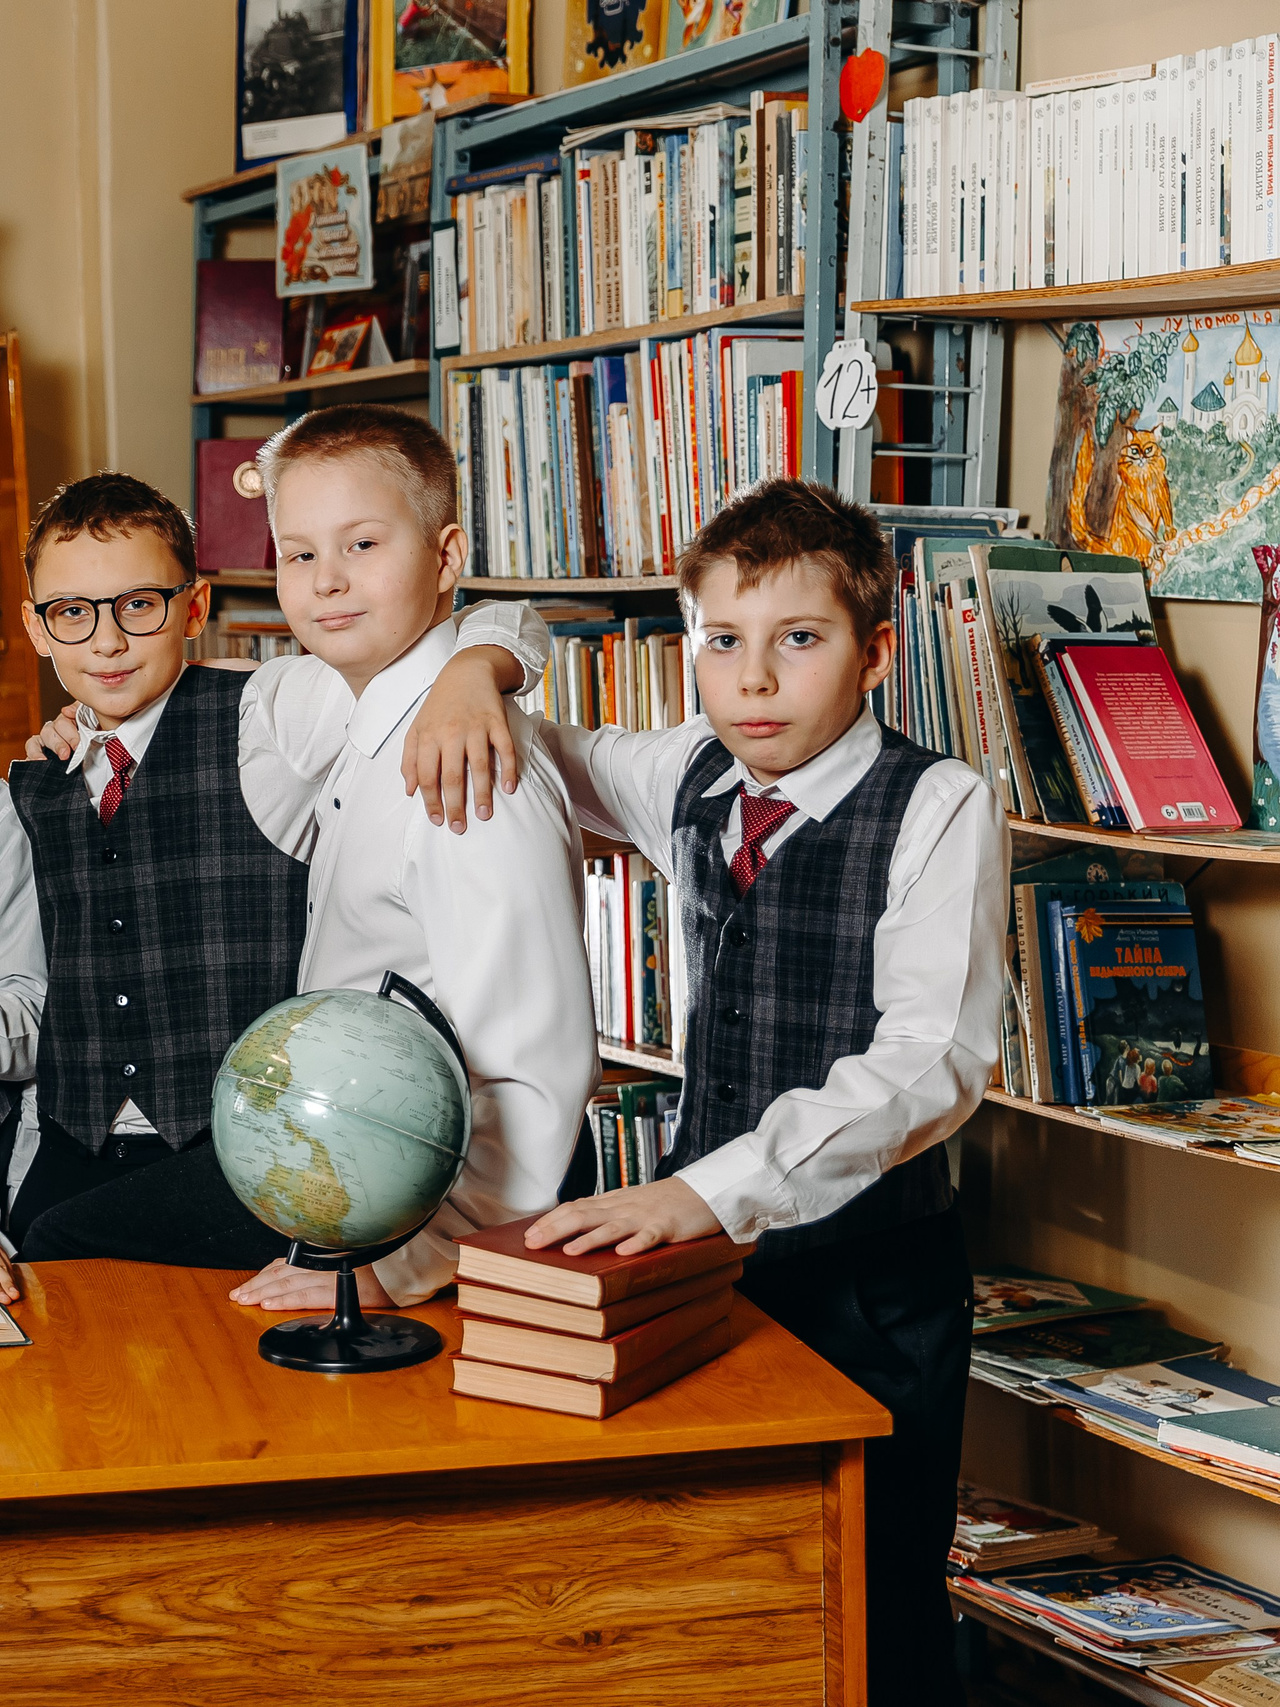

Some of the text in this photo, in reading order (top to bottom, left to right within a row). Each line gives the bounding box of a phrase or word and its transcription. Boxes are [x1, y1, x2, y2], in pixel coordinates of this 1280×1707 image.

[777, 174, 785, 237] ФАНТАЗЁРЫ
[1134, 320, 1143, 335] У
[824, 359, 876, 419] 12+
[976, 690, 989, 755] ПРИКЛЮЧЕНИЯ
[1165, 807, 1174, 817] 6+
[1115, 944, 1163, 964] ТАЙНА
[1155, 966, 1187, 977] ОЗЕРА
[1054, 971, 1066, 1039] ЛИТЕРАТУРЫ
